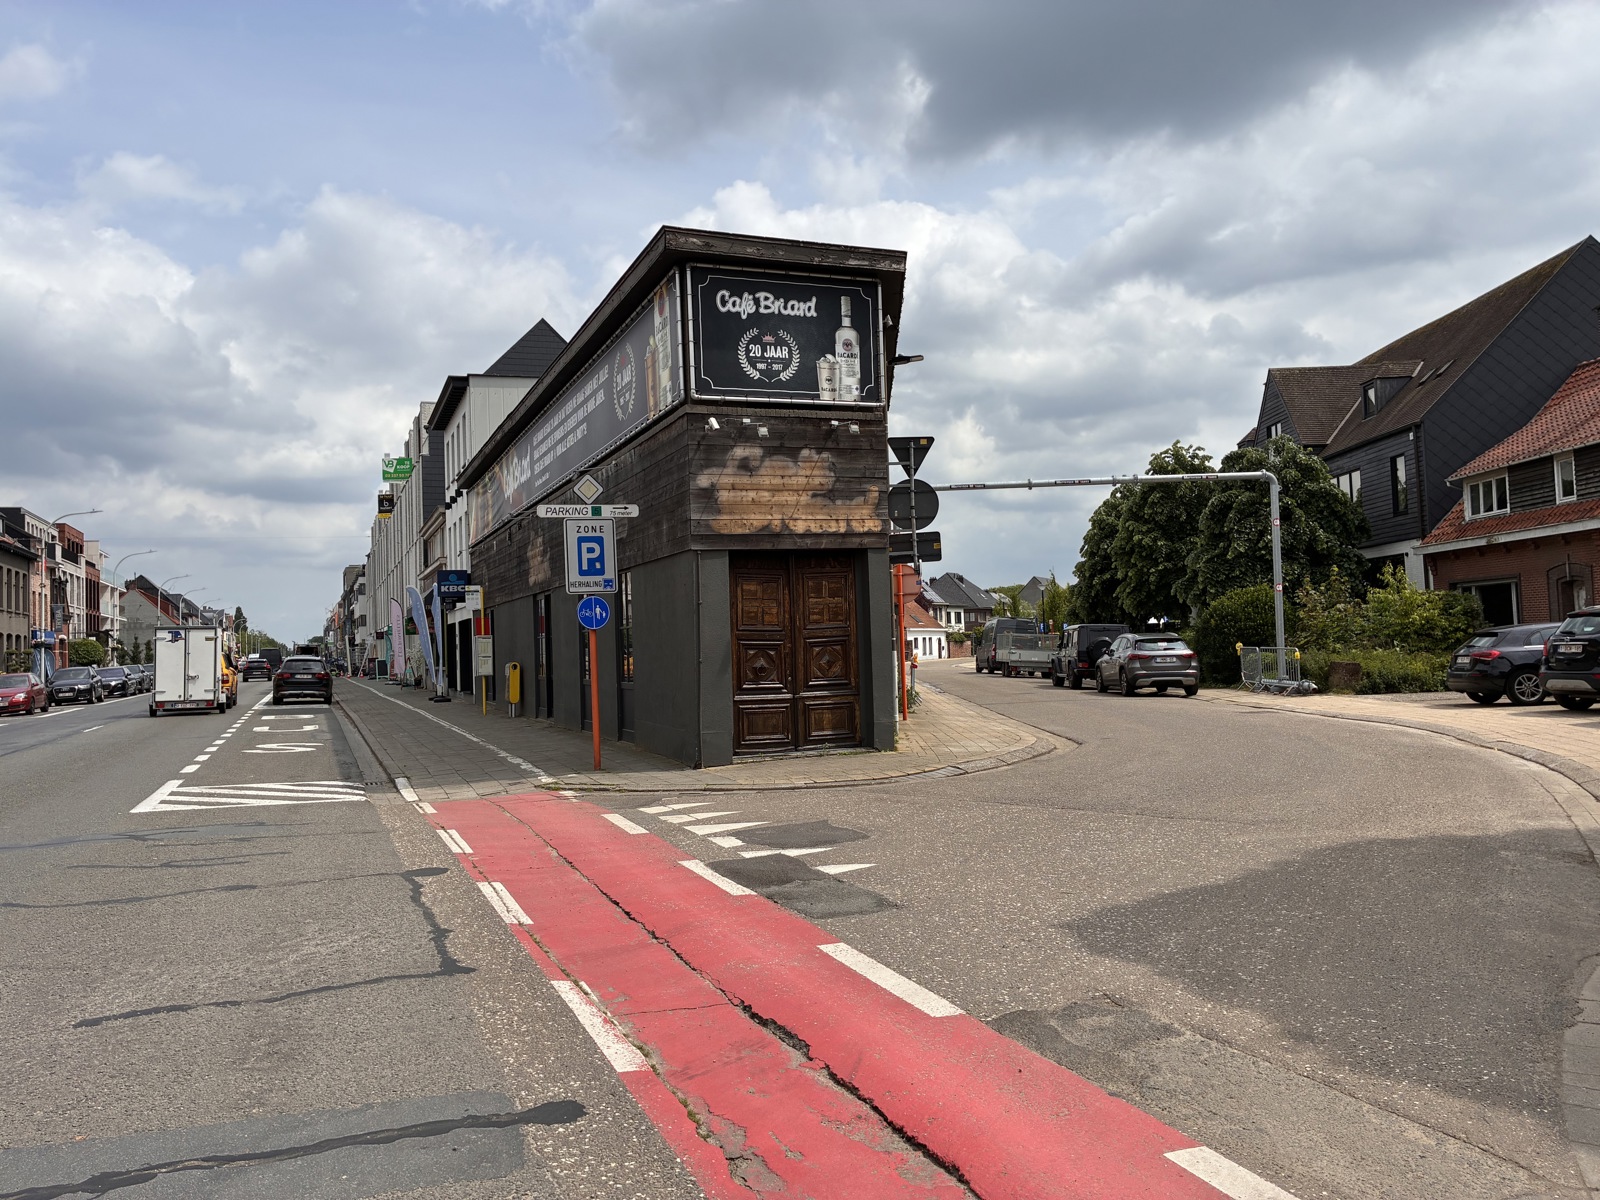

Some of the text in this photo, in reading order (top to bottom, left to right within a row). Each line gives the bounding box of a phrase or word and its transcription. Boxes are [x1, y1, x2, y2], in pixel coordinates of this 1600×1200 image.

[716, 289, 817, 319] Café Briard
[749, 344, 789, 359] 20 JAAR
[756, 362, 767, 370] 1997
[772, 363, 783, 371] 2017
[545, 506, 600, 515] PARKING 5
[576, 525, 605, 534] ZONE
[581, 542, 601, 571] P
[570, 580, 603, 588] HERHALING
